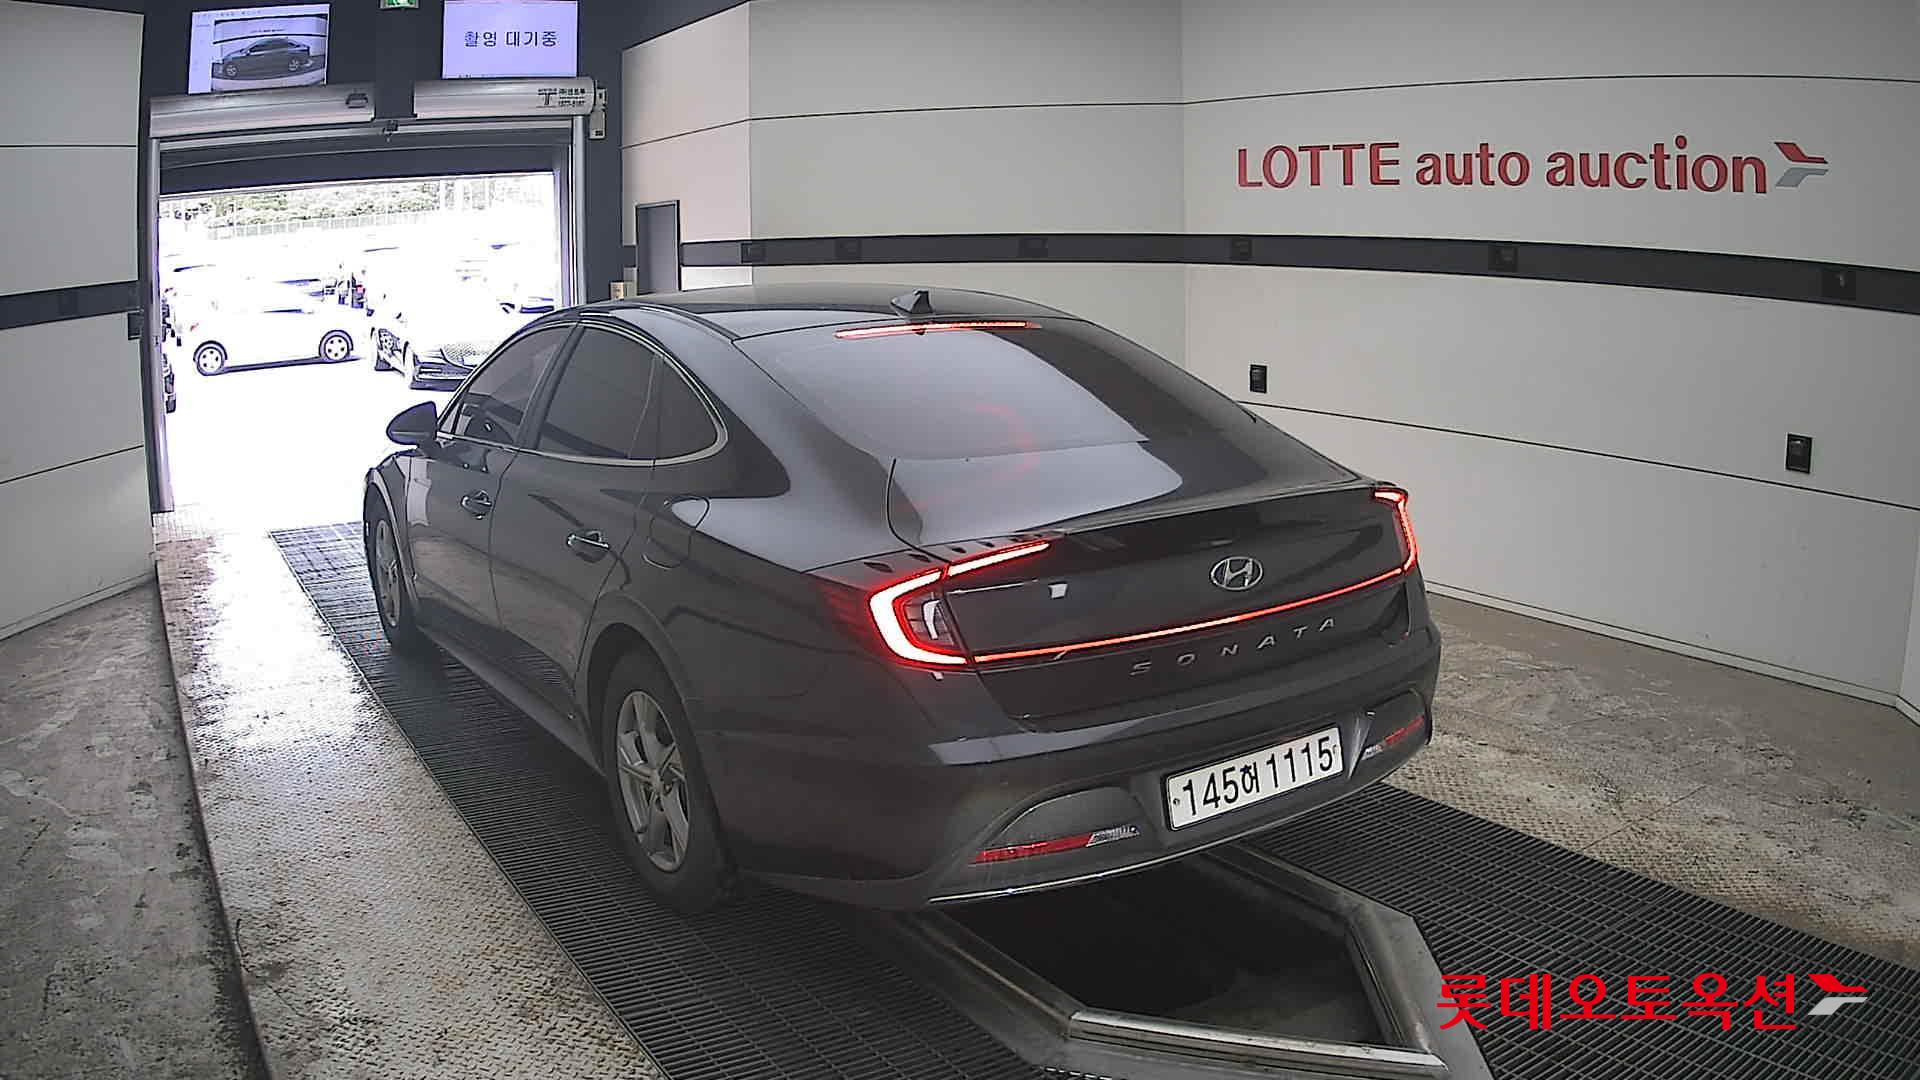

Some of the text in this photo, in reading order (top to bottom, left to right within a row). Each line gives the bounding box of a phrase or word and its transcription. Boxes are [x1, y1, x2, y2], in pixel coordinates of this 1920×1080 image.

[464, 31, 558, 48] 촬영 대기중
[1237, 135, 1768, 195] LOTTE auto auction
[1130, 617, 1336, 676] SONATA
